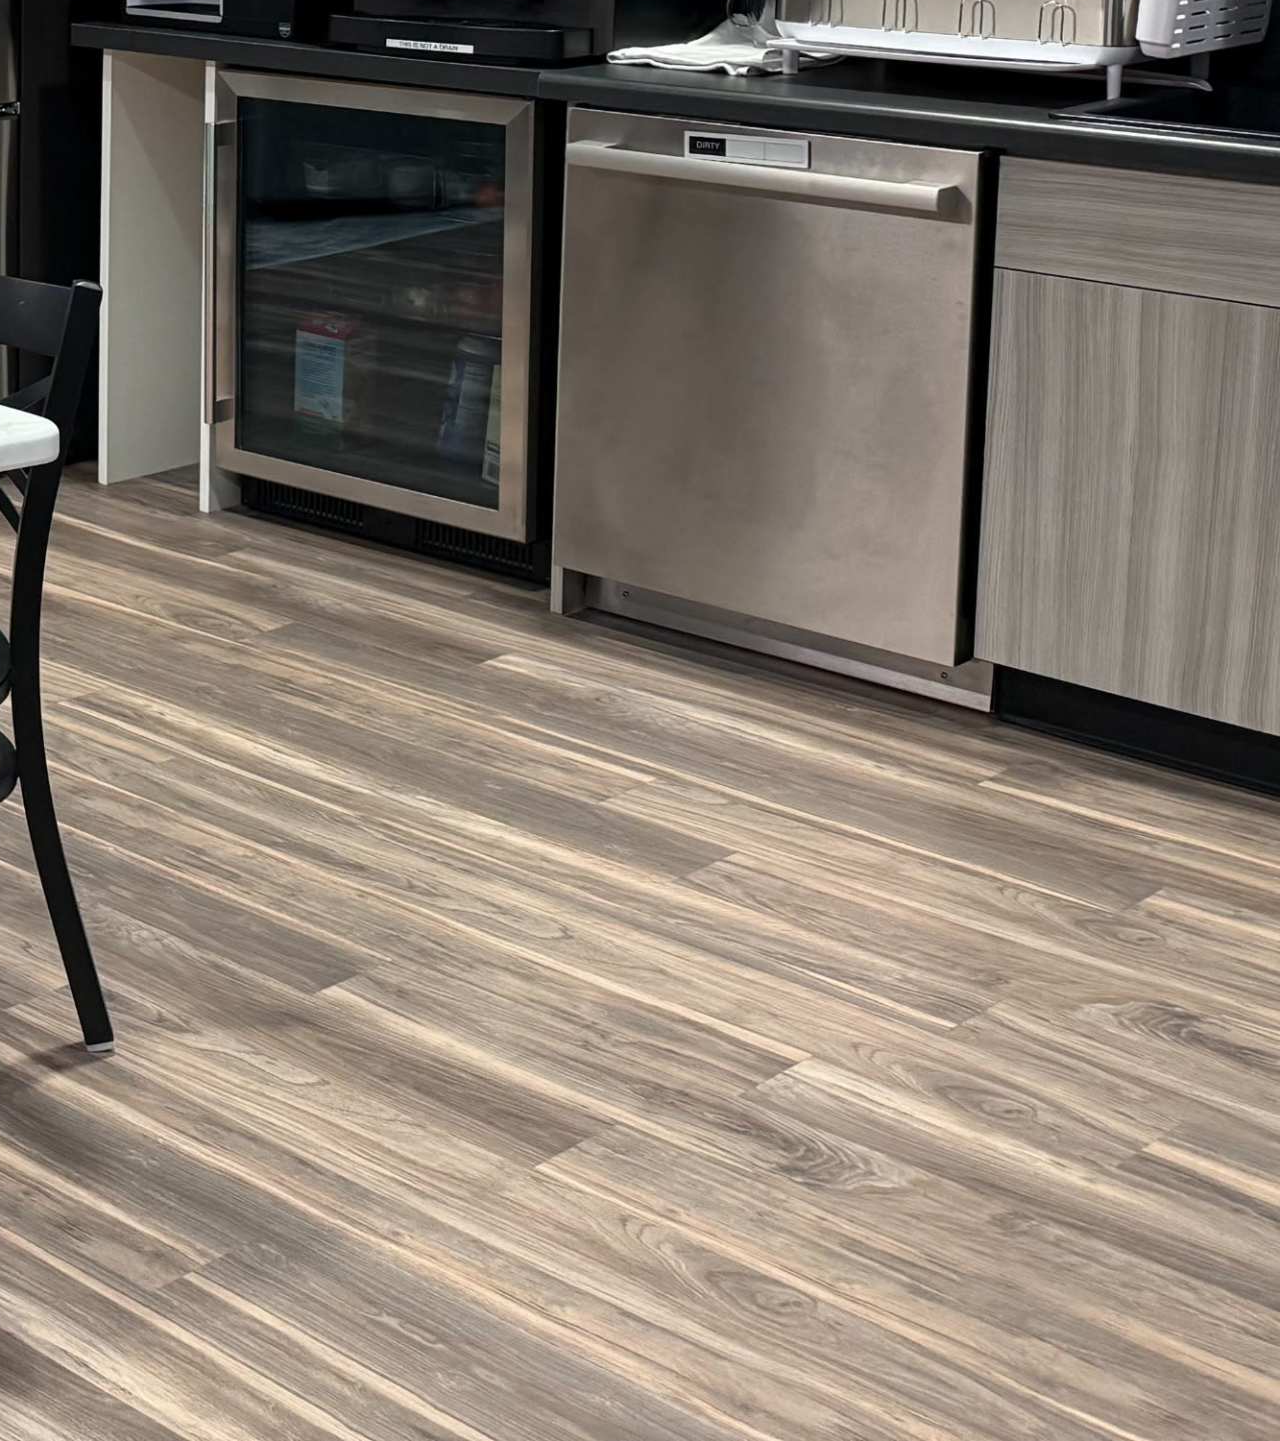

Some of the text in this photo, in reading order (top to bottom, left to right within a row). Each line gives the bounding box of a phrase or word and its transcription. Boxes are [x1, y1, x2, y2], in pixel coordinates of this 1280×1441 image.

[399, 40, 412, 48] THIS
[420, 42, 432, 50] NOT
[439, 44, 458, 52] DRAIN
[696, 140, 721, 150] DIRTY
